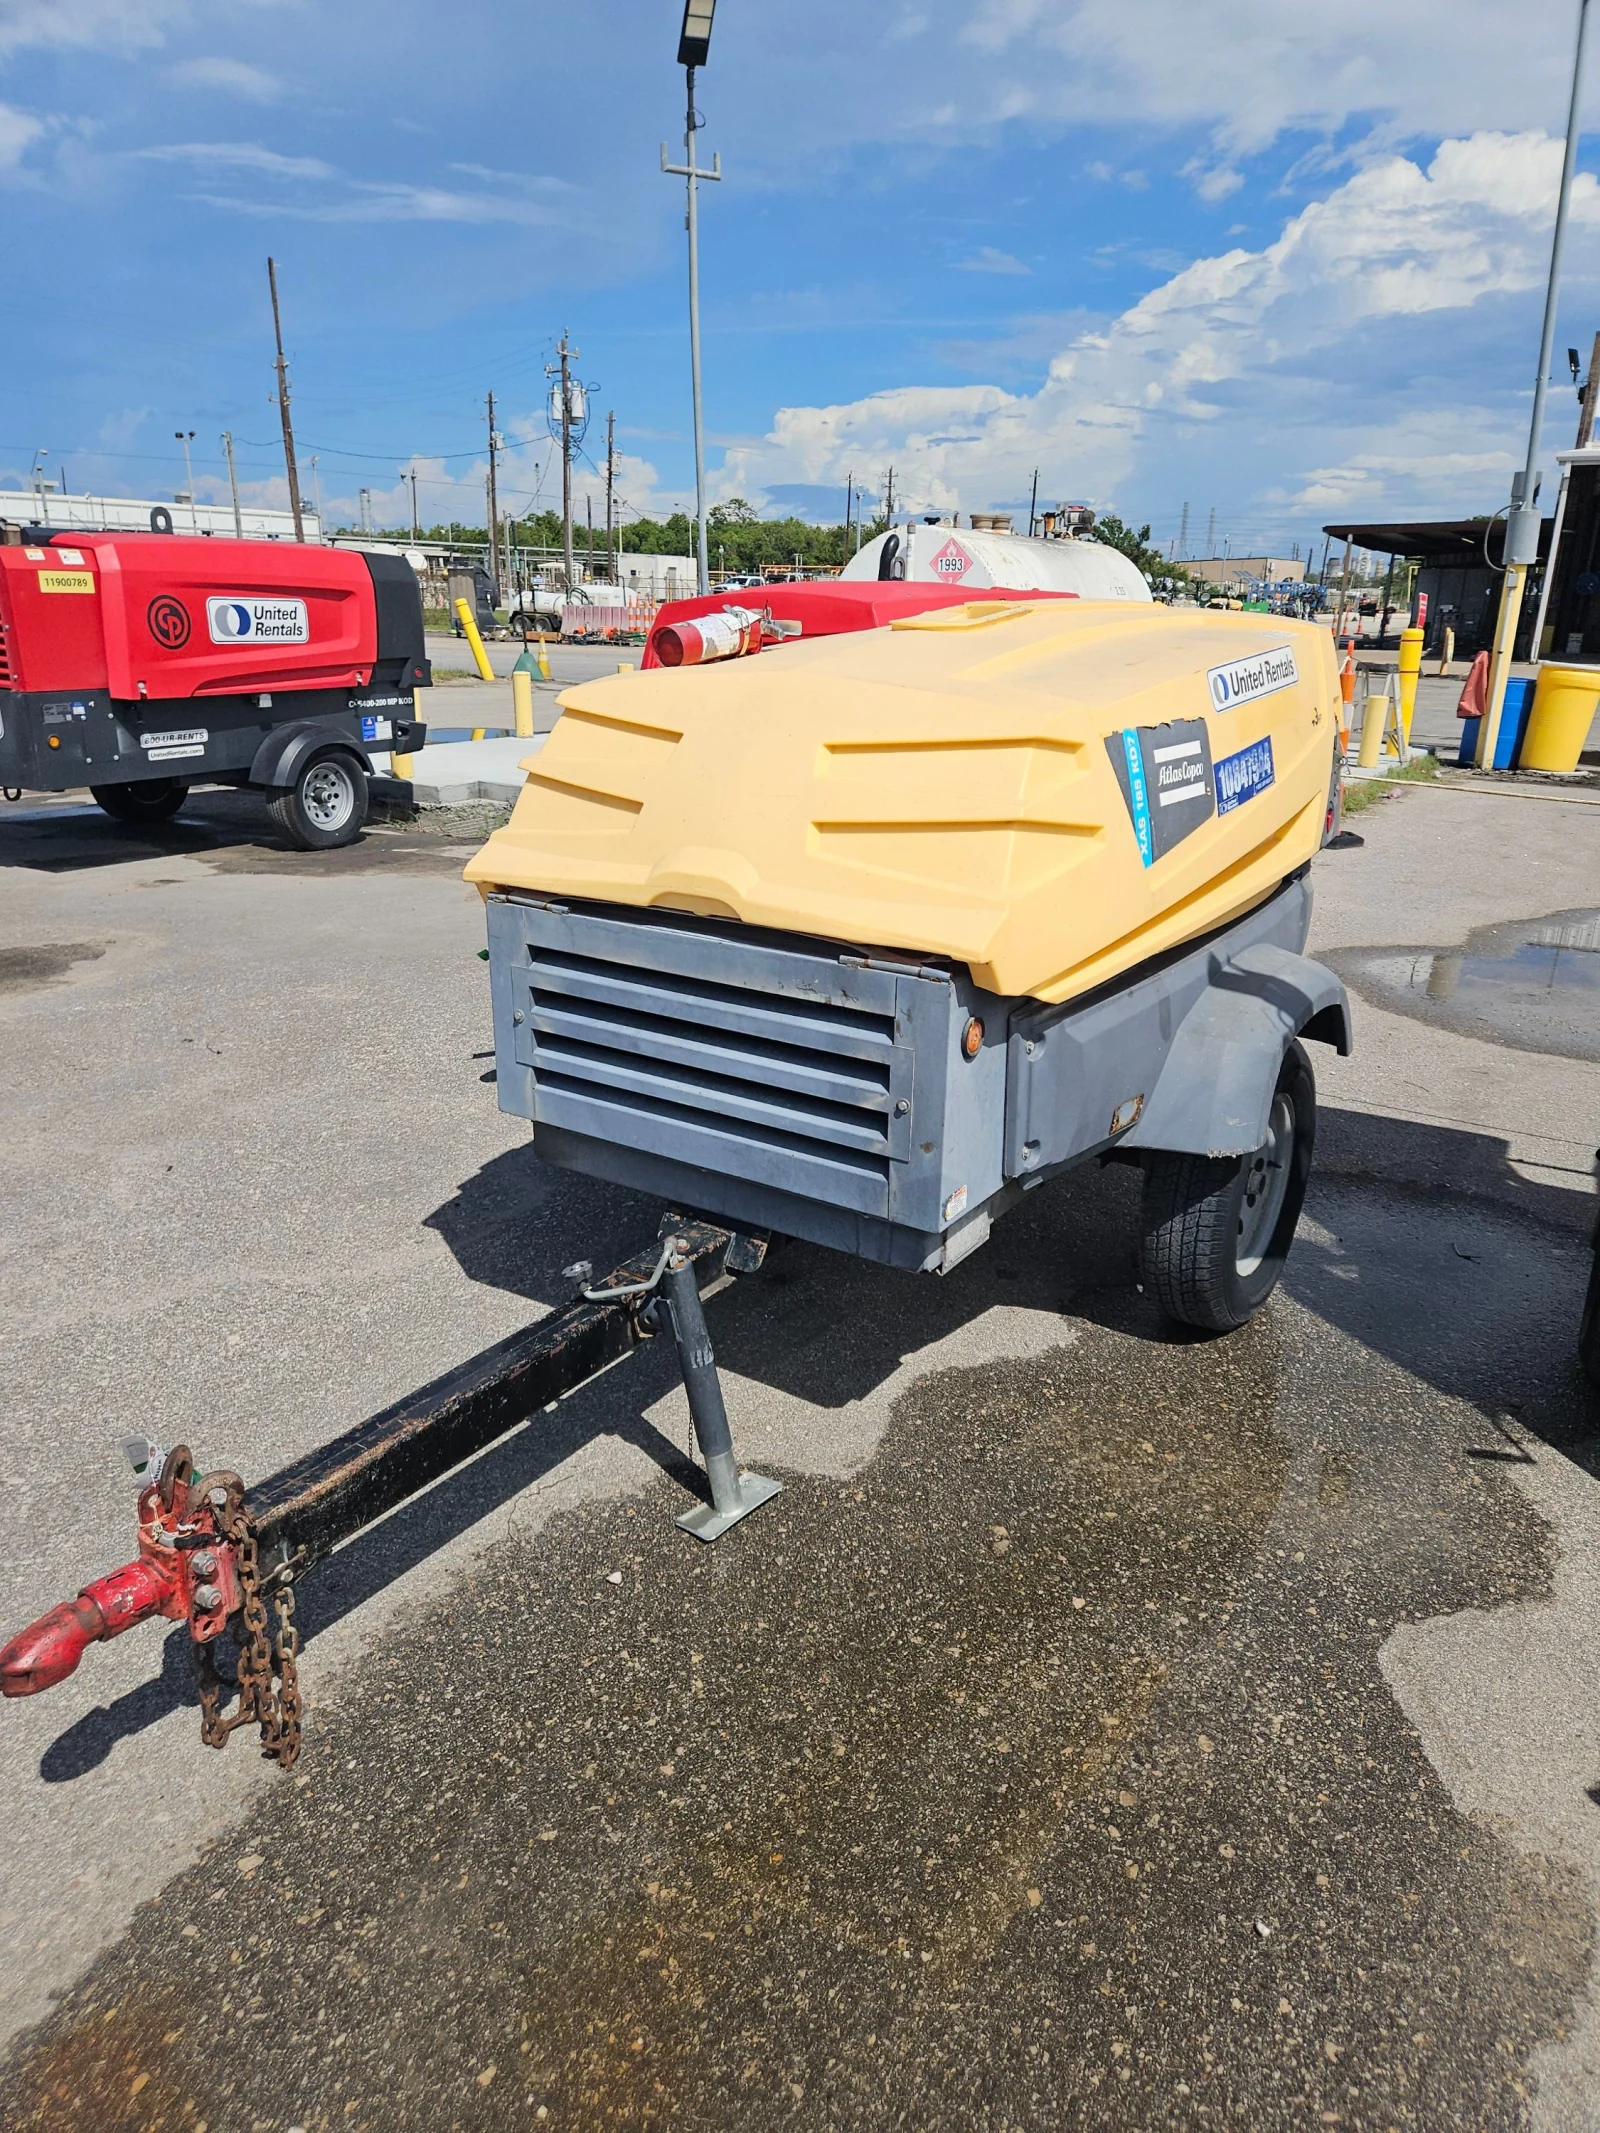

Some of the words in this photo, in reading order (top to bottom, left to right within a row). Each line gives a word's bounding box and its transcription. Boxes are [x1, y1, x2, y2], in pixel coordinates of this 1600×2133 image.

[939, 558, 963, 571] 1993
[45, 577, 88, 587] 11900789
[254, 606, 298, 621] United
[255, 621, 303, 636] Rentals
[1229, 662, 1265, 697] United
[1264, 653, 1295, 685] Rentals
[398, 696, 414, 705] KOD
[1127, 735, 1140, 774] KD7
[1158, 764, 1183, 787] Atlas
[1182, 760, 1204, 782] Copco
[1133, 778, 1145, 811] 185
[1138, 816, 1149, 855] XAS
